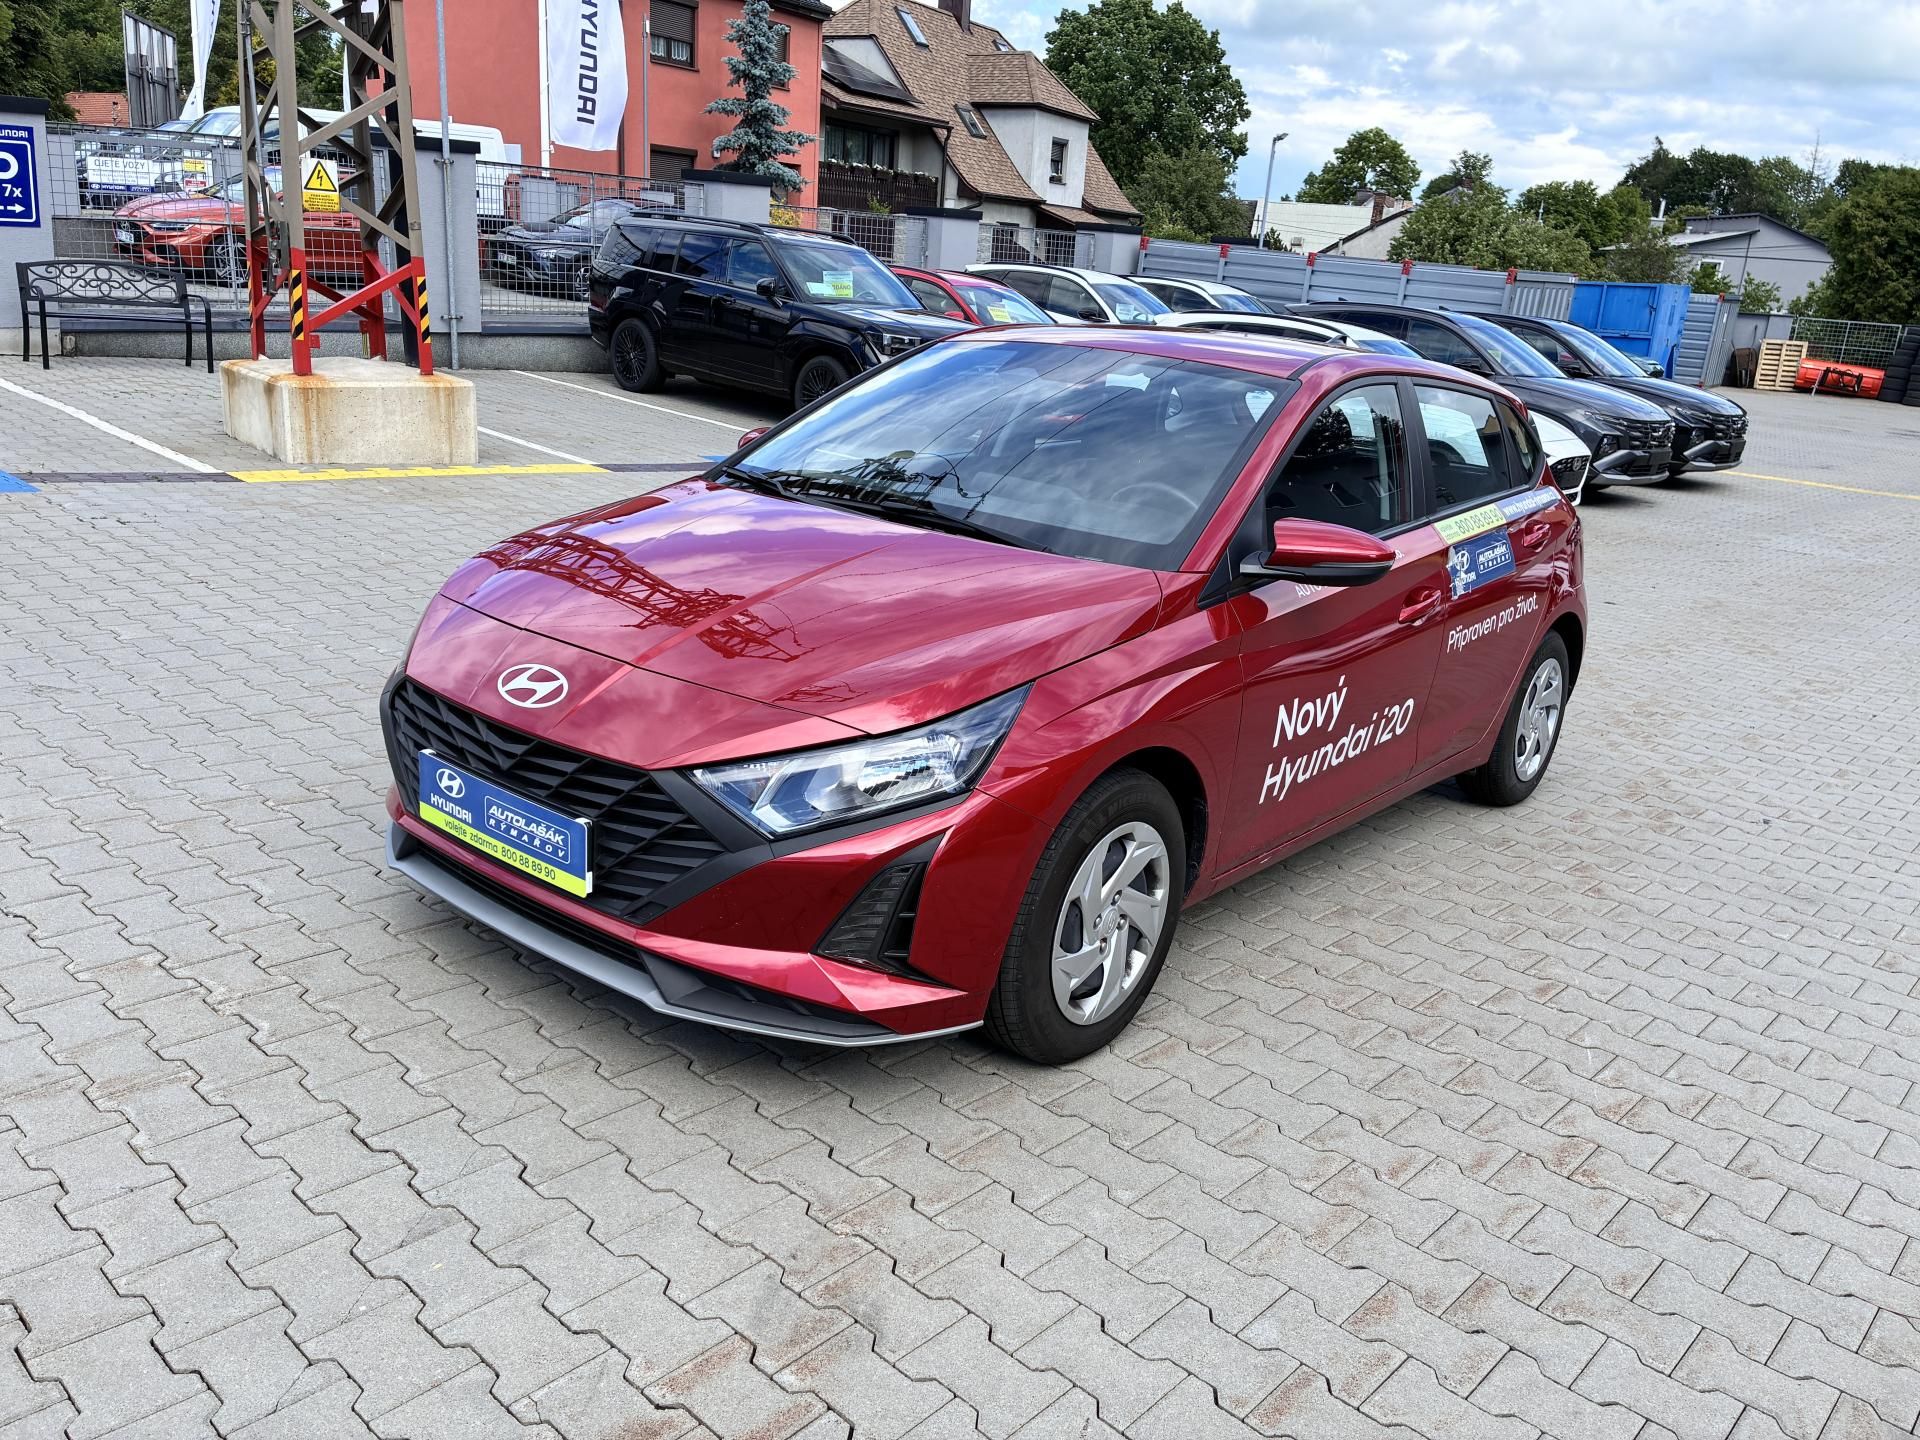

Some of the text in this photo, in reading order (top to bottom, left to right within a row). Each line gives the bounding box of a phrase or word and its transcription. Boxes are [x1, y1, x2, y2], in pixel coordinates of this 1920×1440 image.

[2, 184, 22, 198] 7x
[1447, 592, 1538, 653] Připraven pro život.
[1272, 674, 1348, 748] Nový
[1258, 698, 1415, 805] Hyundai i20
[430, 793, 472, 824] HYUNDAI
[488, 805, 566, 845] AUTOLAŠÁK
[444, 818, 556, 880] volejte zdarma 800 88 89 90
